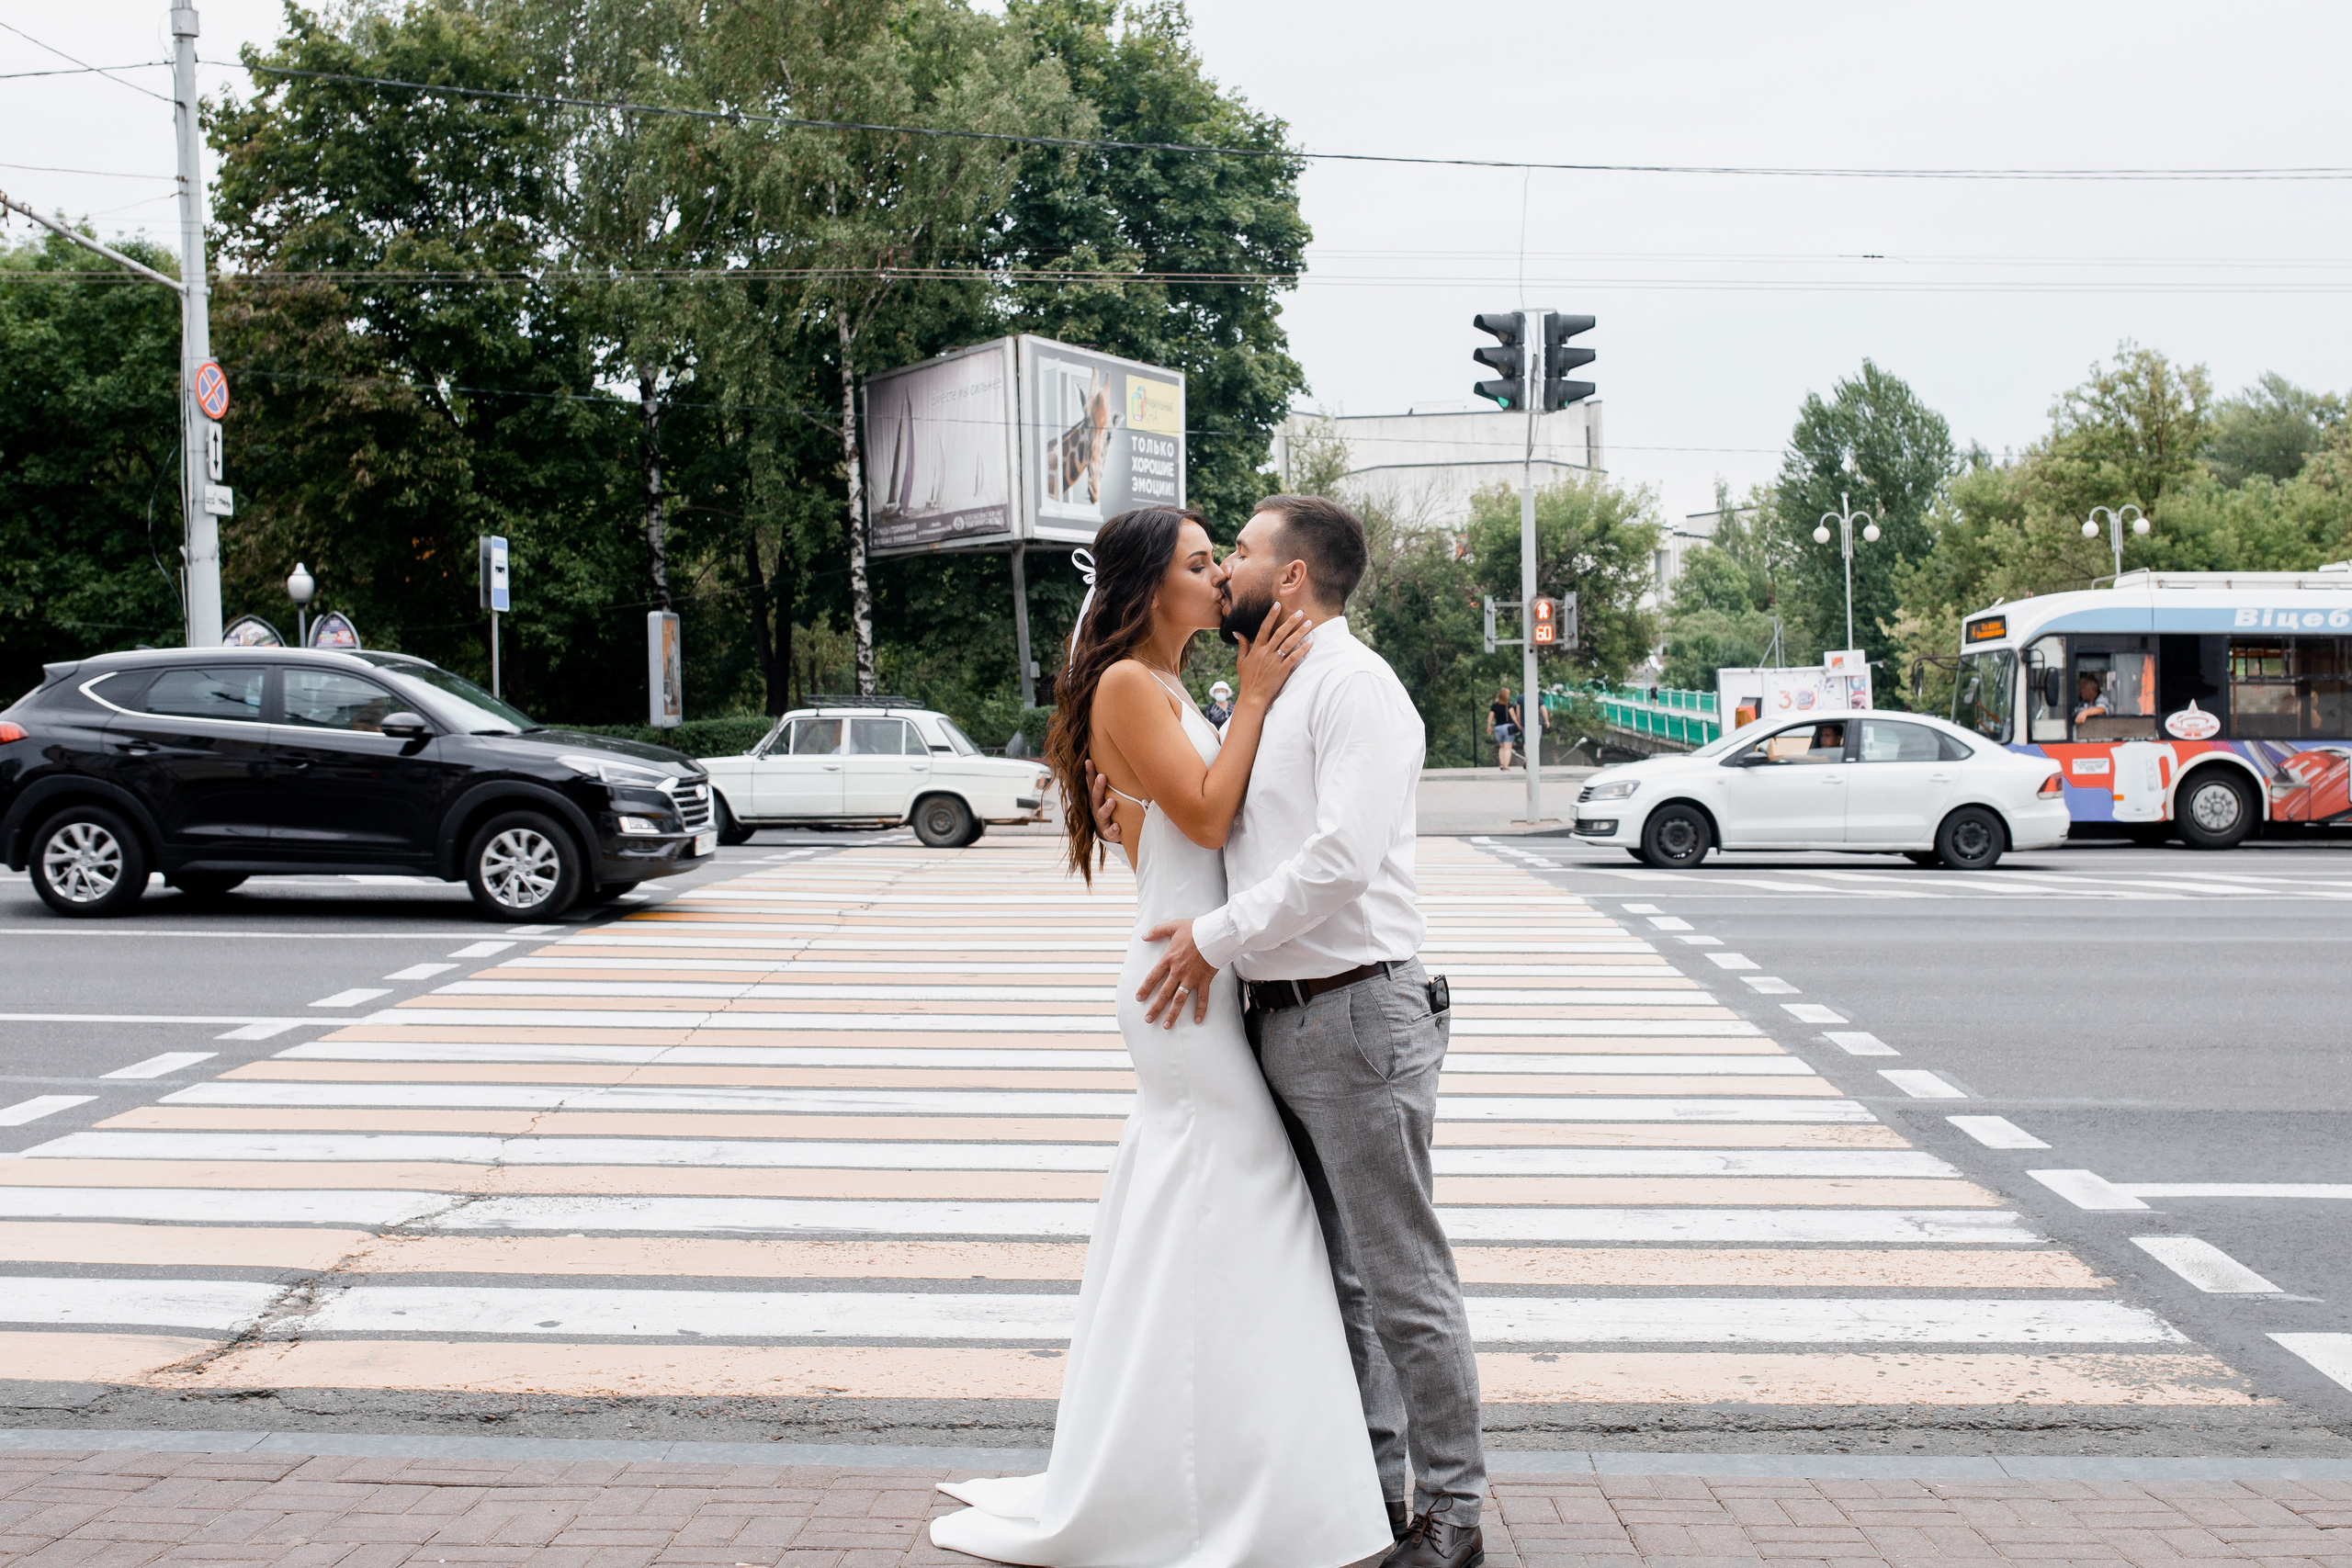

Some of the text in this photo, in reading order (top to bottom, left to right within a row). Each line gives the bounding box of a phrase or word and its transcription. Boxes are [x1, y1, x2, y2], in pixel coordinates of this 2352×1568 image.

[1131, 435, 1174, 457] ТОЛЬКО
[1131, 456, 1174, 478] ХОРОШИЕ
[1131, 476, 1174, 497] ЭМОЦИИ!
[1535, 626, 1553, 641] 60
